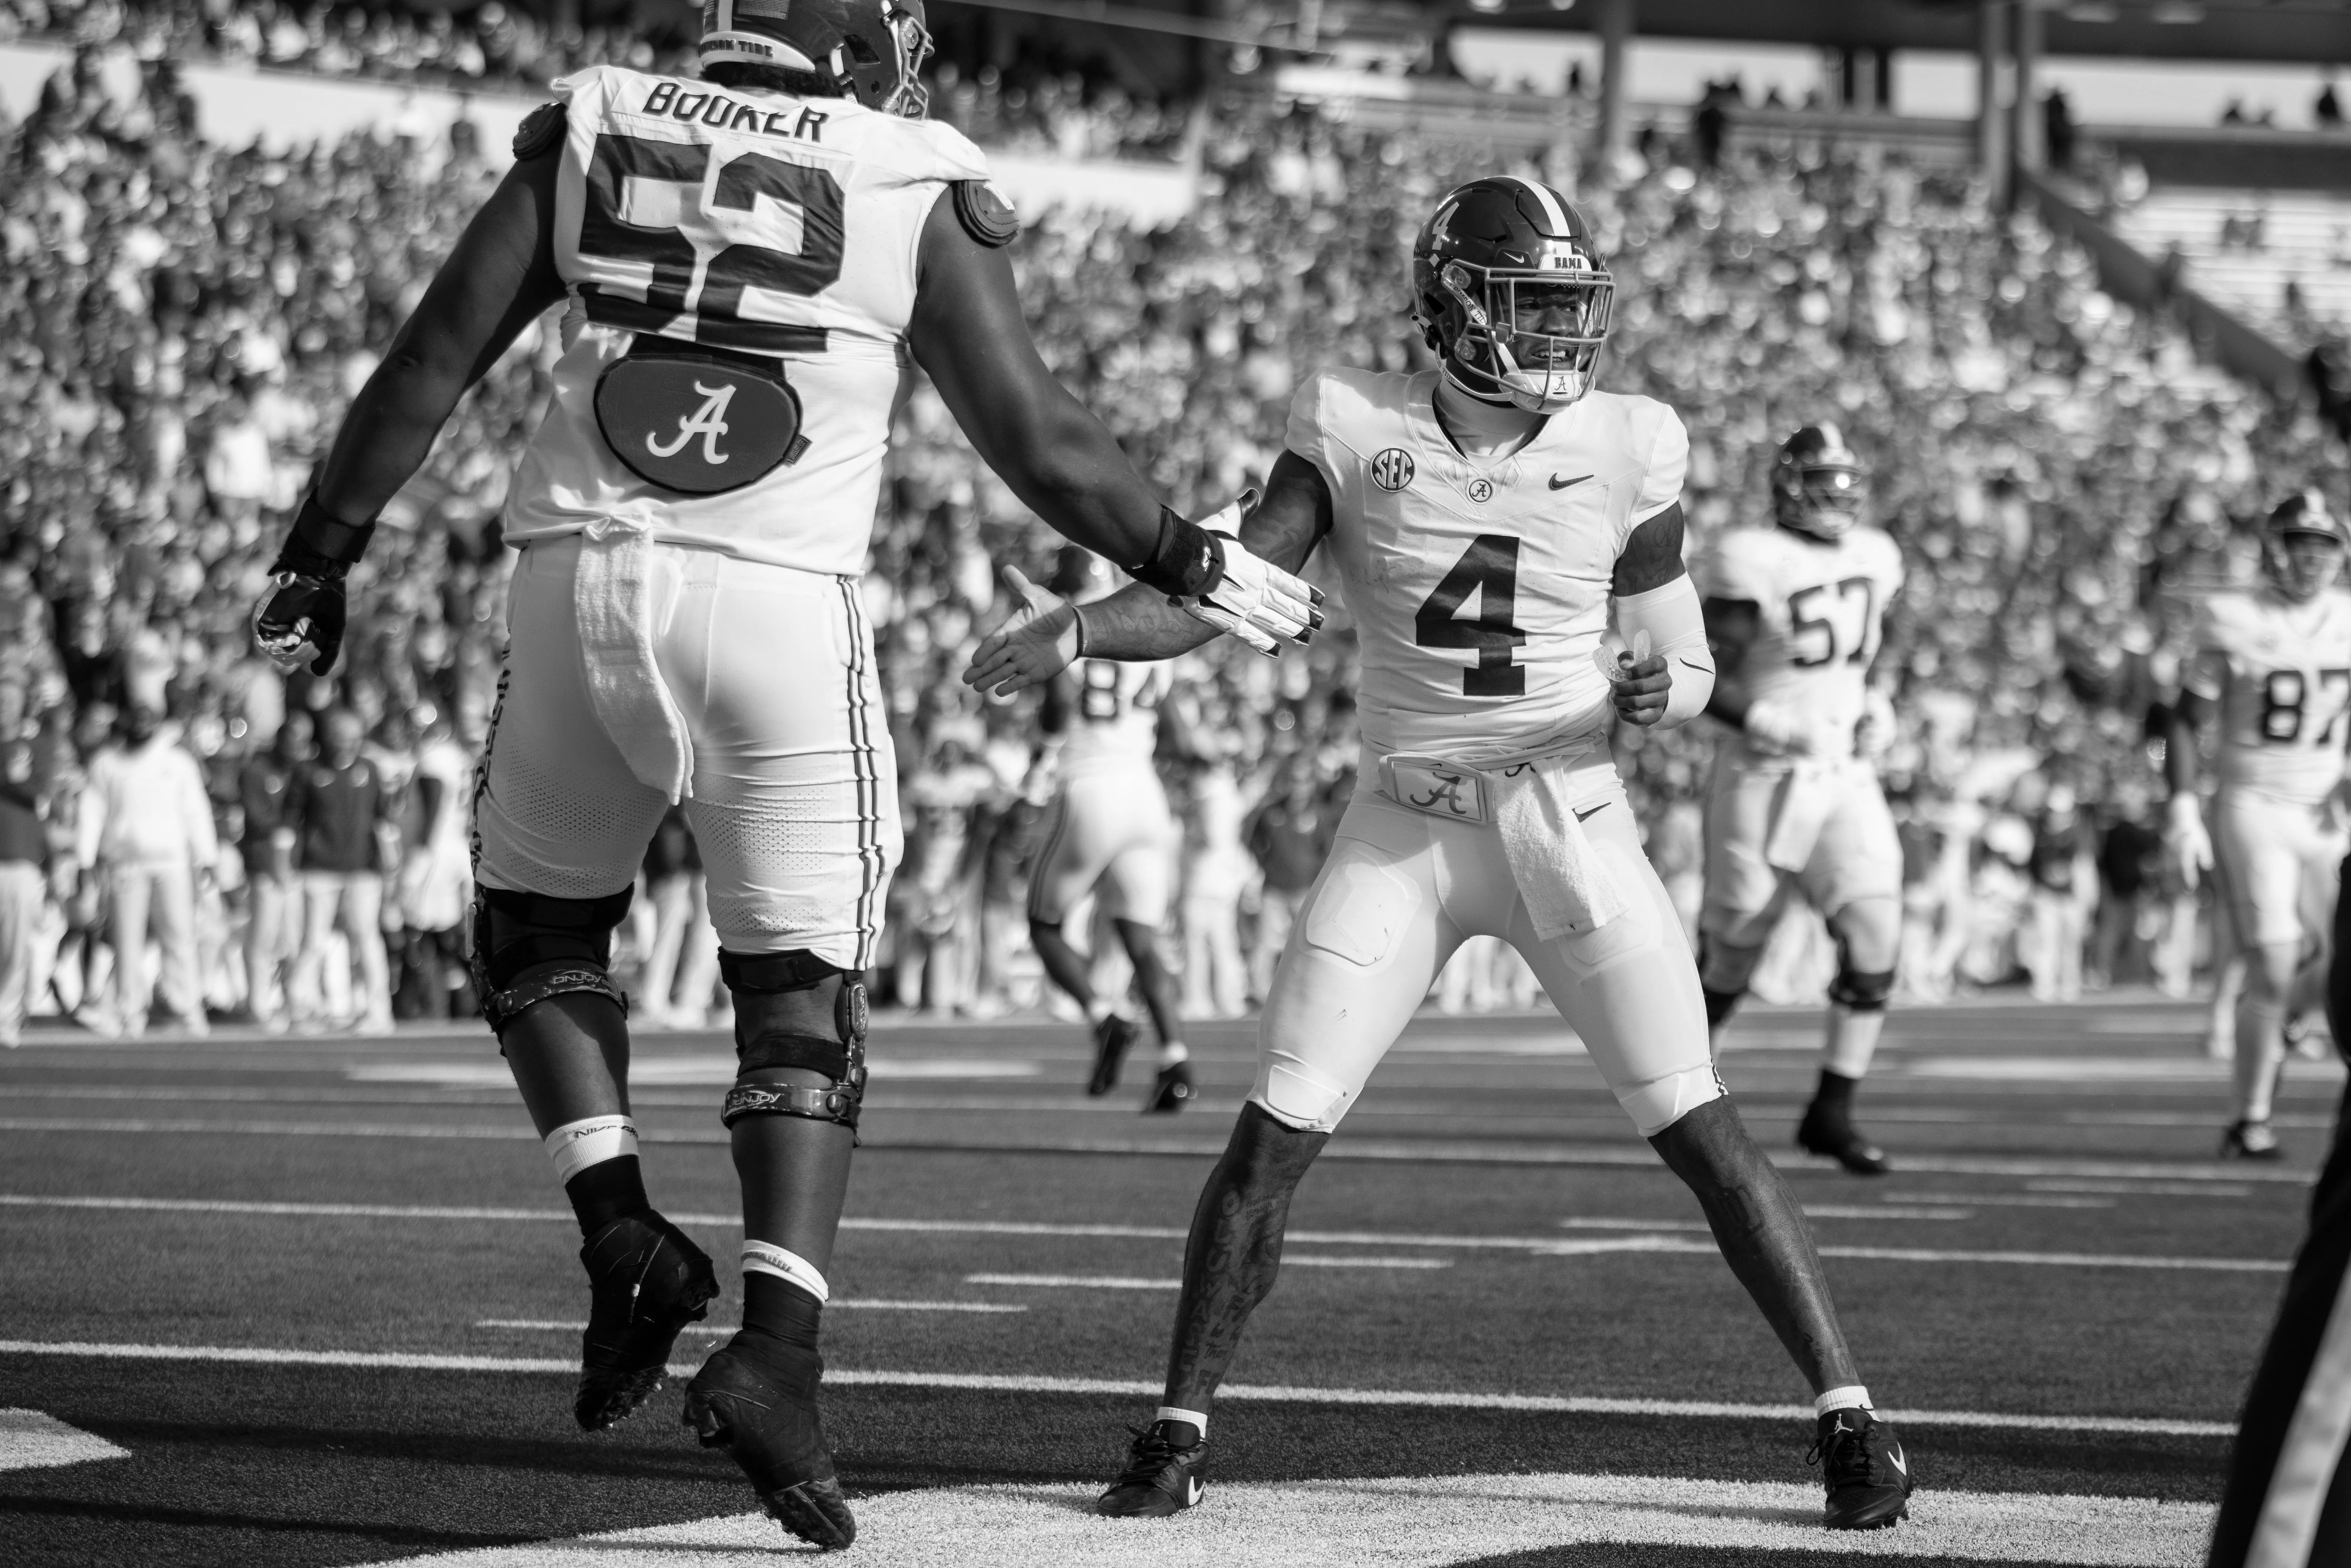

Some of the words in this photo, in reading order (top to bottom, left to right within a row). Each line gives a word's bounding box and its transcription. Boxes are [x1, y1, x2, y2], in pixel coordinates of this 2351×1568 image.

[738, 40, 774, 58] TIDE
[642, 83, 830, 143] BOOKER
[578, 133, 846, 353] 52
[1432, 202, 1459, 250] 4
[1555, 257, 1582, 269] BAMA
[1554, 376, 1567, 391] A
[645, 380, 736, 464] A
[1374, 450, 1412, 488] SEC
[1472, 483, 1487, 497] A
[1415, 534, 1526, 696] 4
[1787, 577, 1873, 668] 57
[2263, 669, 2351, 744] 87
[1410, 772, 1467, 815] A
